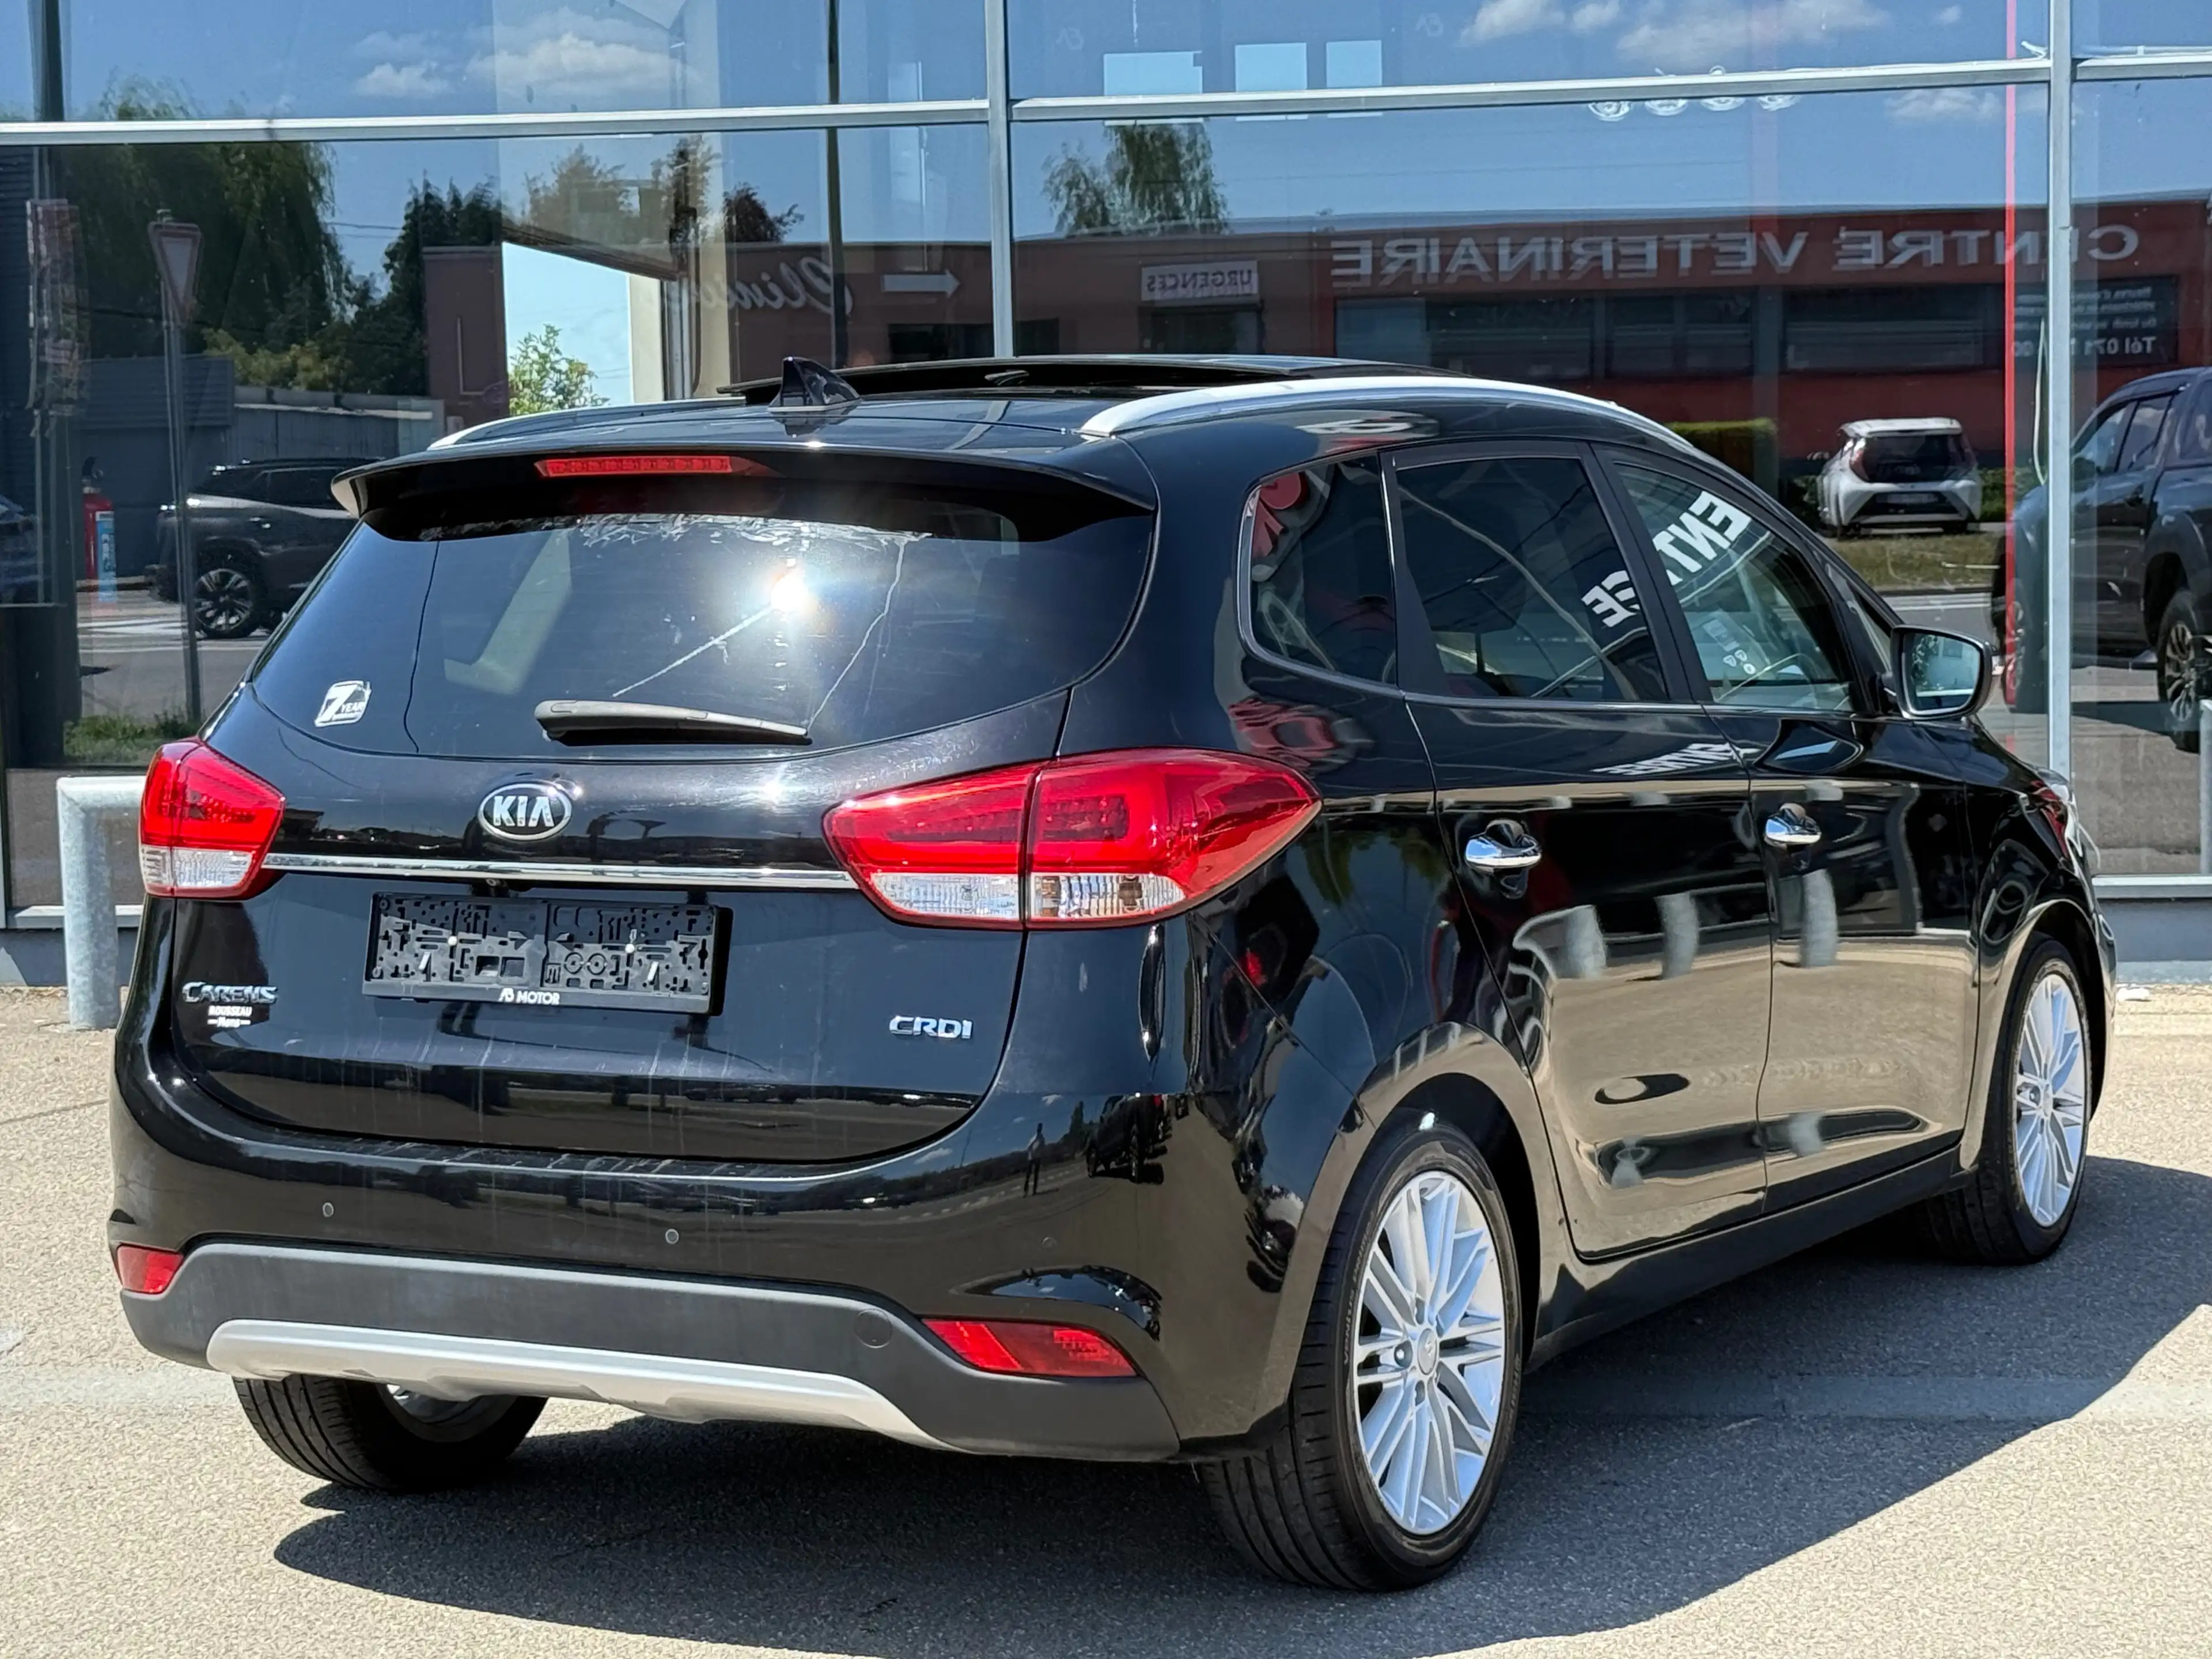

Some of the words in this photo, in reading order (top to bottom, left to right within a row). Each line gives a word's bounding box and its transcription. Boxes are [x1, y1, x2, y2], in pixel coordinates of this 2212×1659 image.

[493, 796, 555, 827] KIA
[516, 990, 559, 1005] MOTOR
[889, 1015, 973, 1039] CRDI
